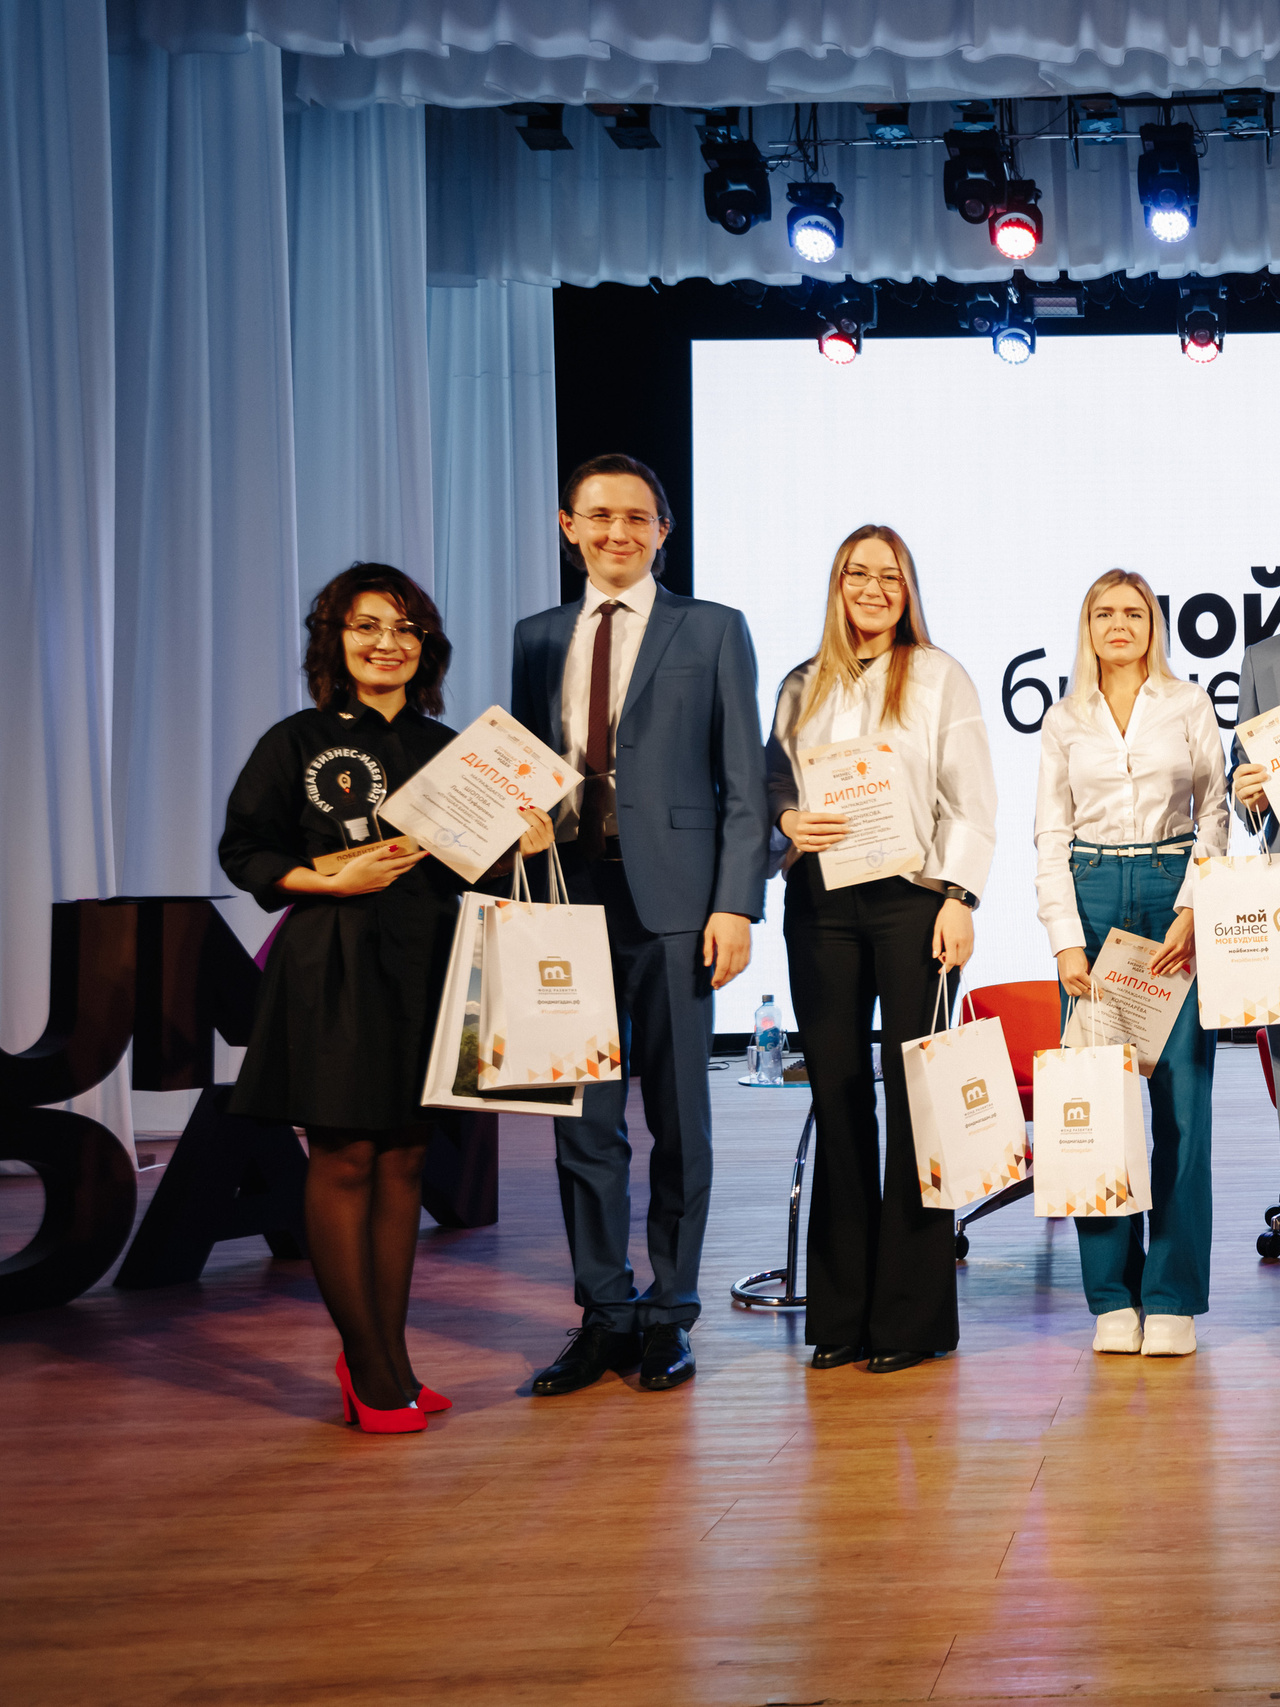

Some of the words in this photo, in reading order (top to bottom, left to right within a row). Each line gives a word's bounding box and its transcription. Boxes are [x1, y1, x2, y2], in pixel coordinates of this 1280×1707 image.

[306, 769, 334, 813] ЛУЧШАЯ
[368, 783, 383, 804] 2021
[460, 752, 532, 807] ДИПЛОМ
[825, 779, 890, 806] ДИПЛОМ
[1214, 922, 1268, 937] бизнес
[1236, 909, 1267, 924] мой
[1215, 937, 1232, 945] МОЕ
[1233, 935, 1268, 944] БУДУЩЕЕ
[1104, 970, 1171, 1001] ДИПЛОМ
